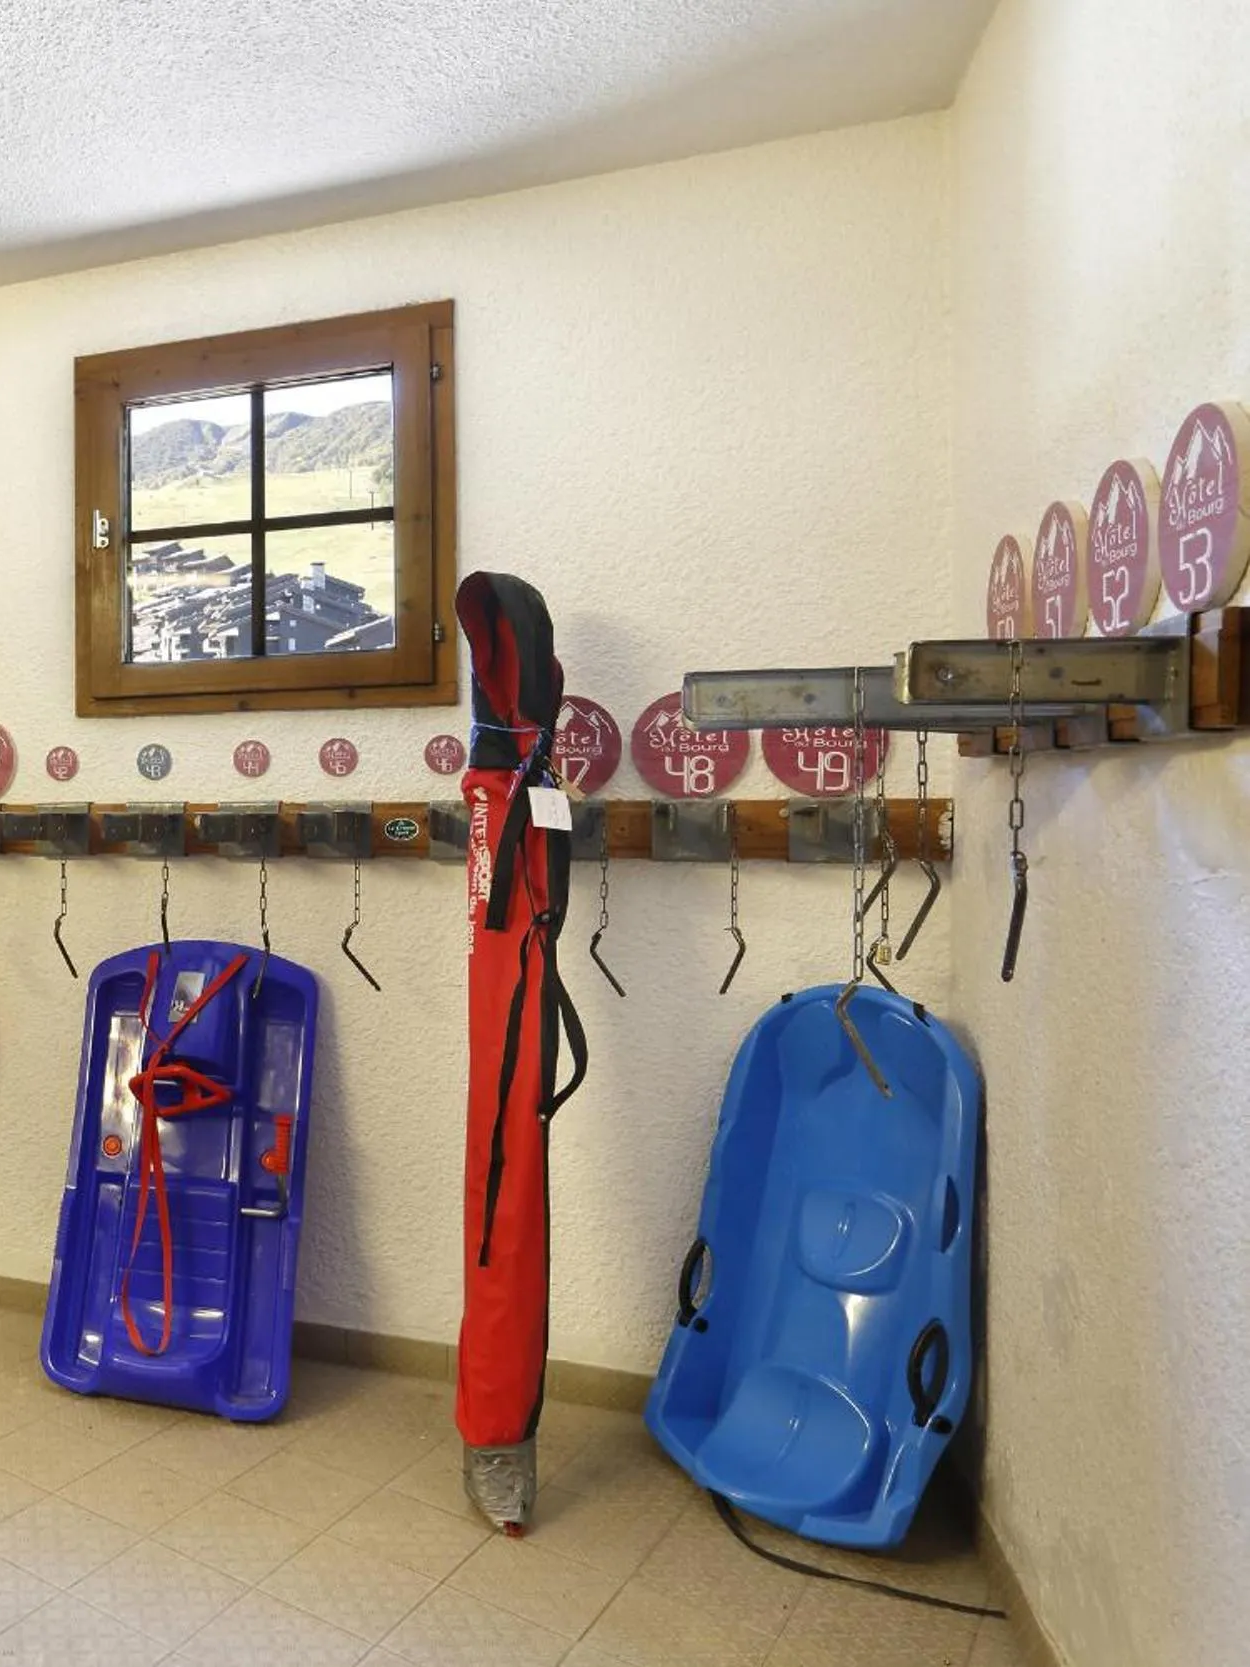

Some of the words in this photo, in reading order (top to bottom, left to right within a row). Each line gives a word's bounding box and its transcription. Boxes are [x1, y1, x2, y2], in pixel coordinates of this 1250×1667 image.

[1188, 498, 1225, 526] Bourg
[1110, 543, 1137, 563] Bourg
[1179, 527, 1212, 604] 53
[1102, 566, 1130, 632] 52
[1046, 595, 1062, 639] 51
[556, 729, 600, 746] ôtel
[556, 746, 603, 756] Bourg
[679, 743, 730, 753] Bourg
[53, 766, 71, 779] 42
[664, 755, 715, 794] 48
[798, 751, 849, 791] 49
